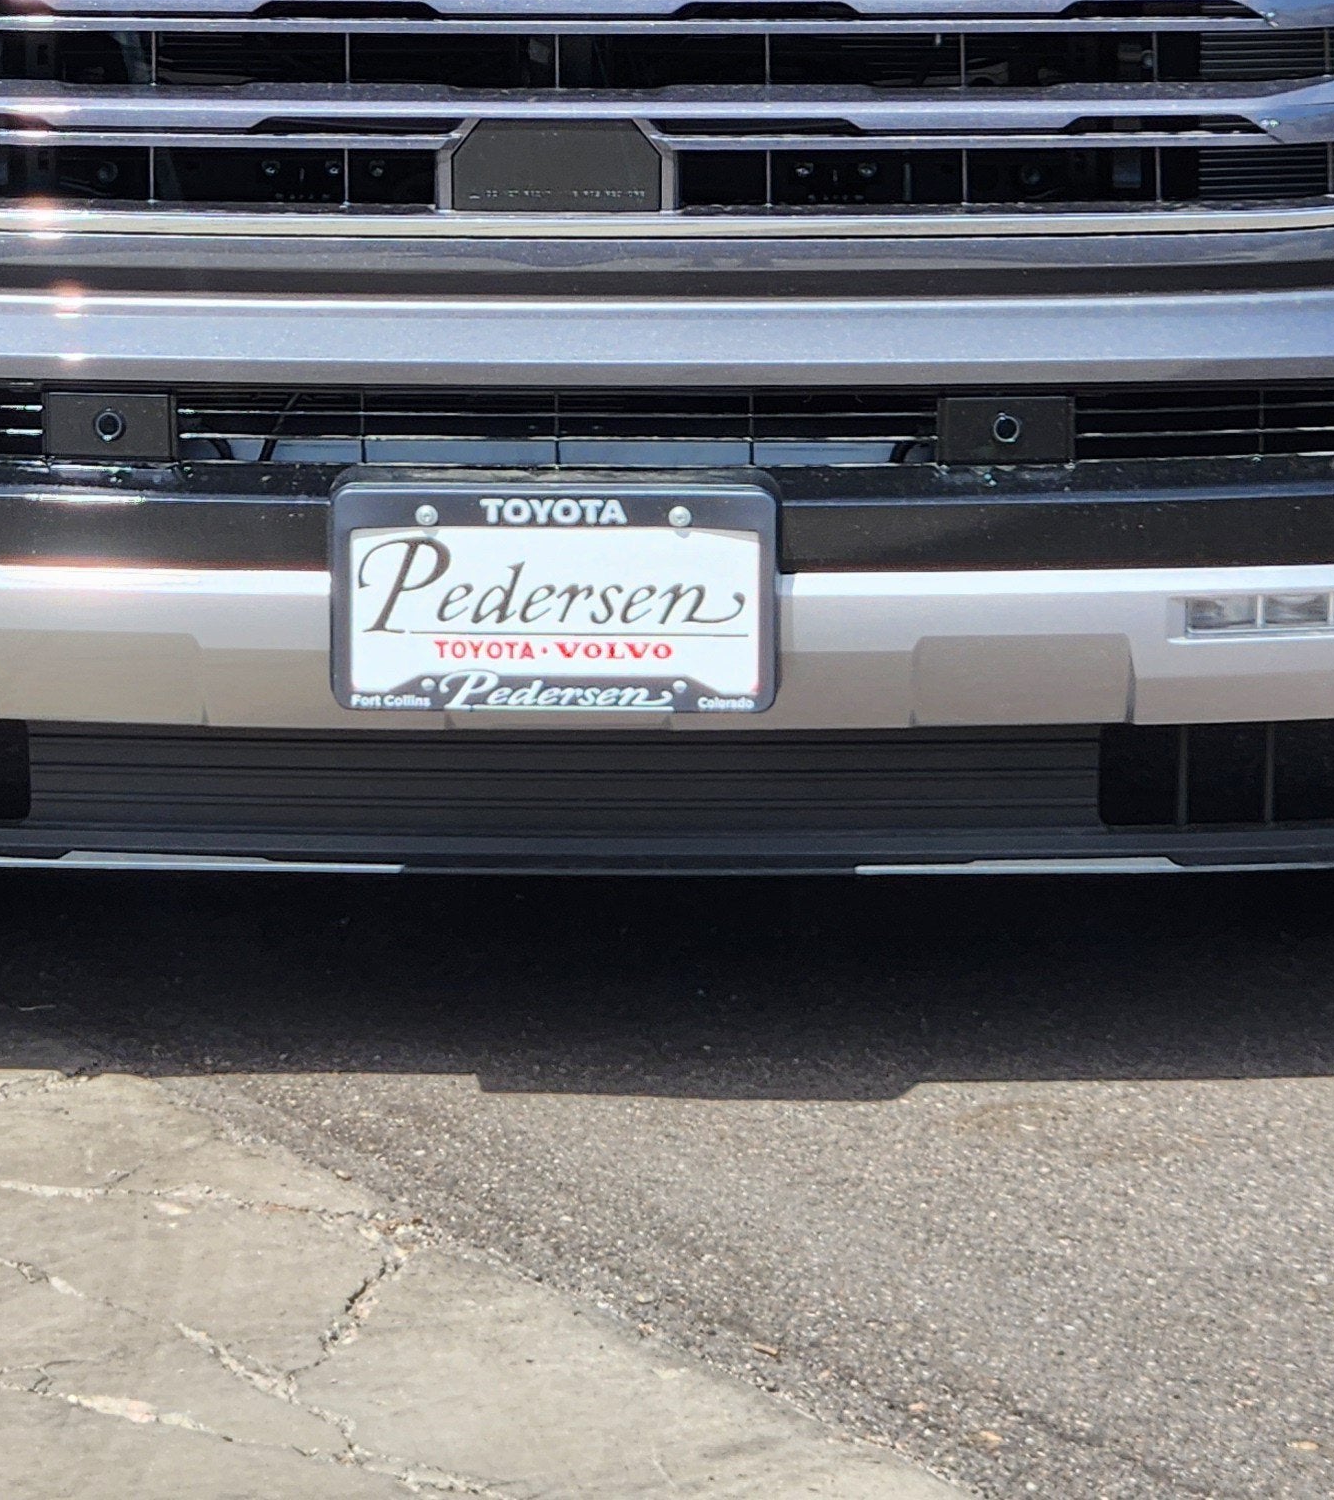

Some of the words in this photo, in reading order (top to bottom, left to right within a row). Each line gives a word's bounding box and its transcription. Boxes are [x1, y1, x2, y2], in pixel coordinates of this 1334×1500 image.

[479, 498, 628, 525] TOYOTA
[358, 535, 746, 634] Pedersen
[434, 640, 535, 660] TOYOTA
[554, 641, 673, 660] VOLVO
[350, 693, 382, 708] Fort
[384, 693, 432, 708] Collins
[439, 669, 674, 710] Pedersen
[697, 695, 755, 711] Colorado
